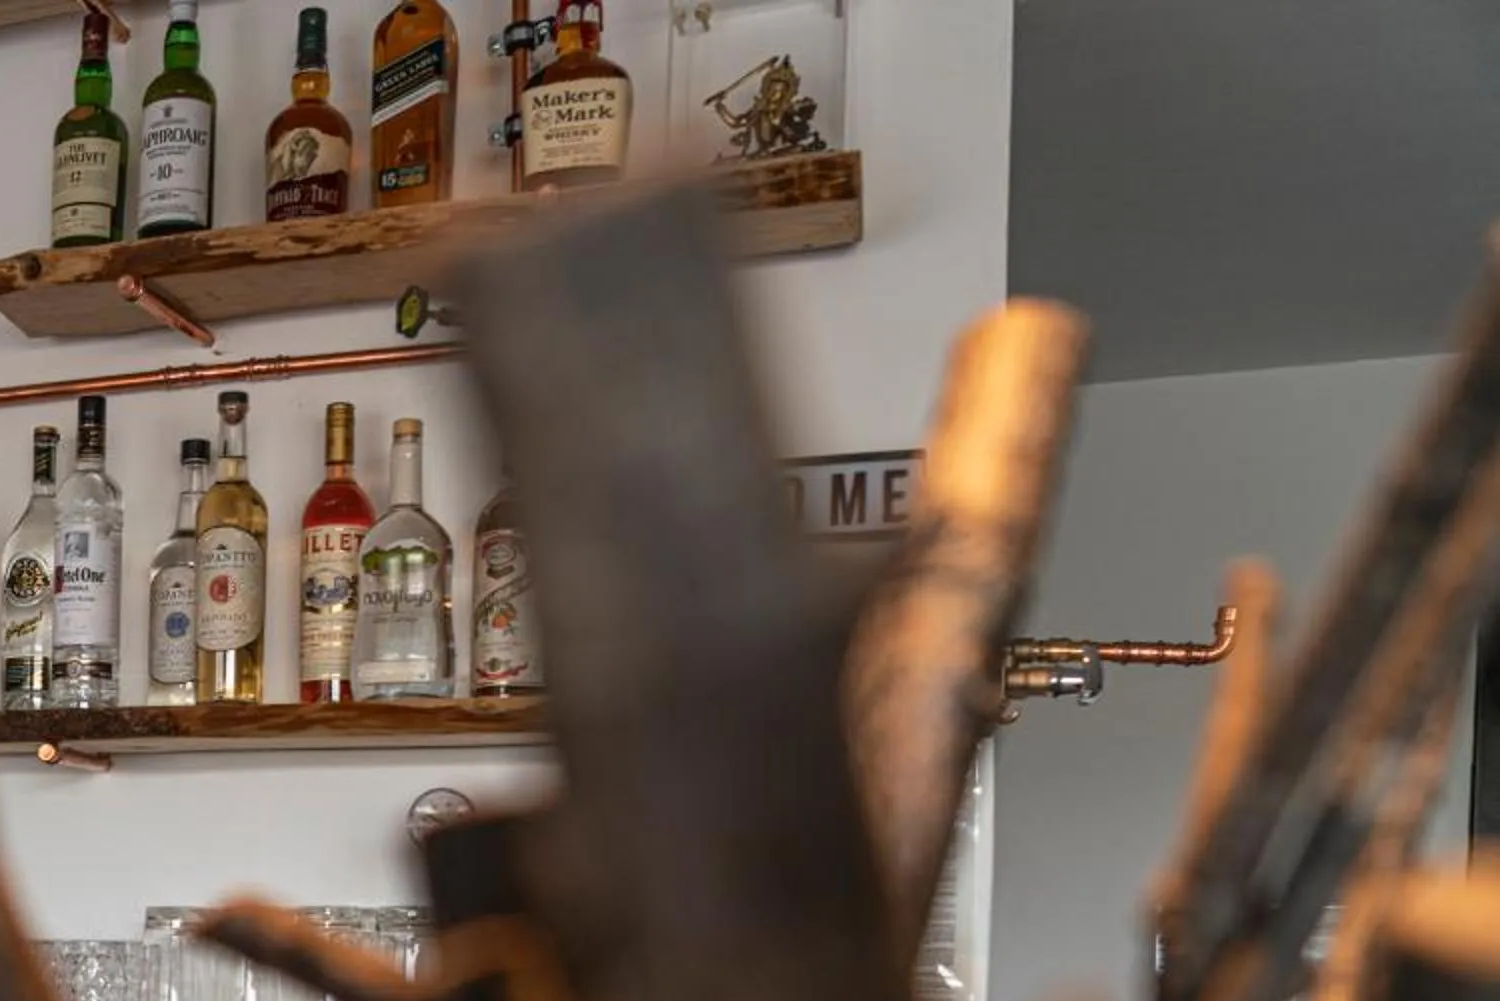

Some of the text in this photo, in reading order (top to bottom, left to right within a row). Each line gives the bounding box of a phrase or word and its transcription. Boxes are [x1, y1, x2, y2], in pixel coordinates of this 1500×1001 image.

[532, 88, 616, 110] Maker's
[555, 105, 615, 124] Mark
[157, 162, 173, 181] 10
